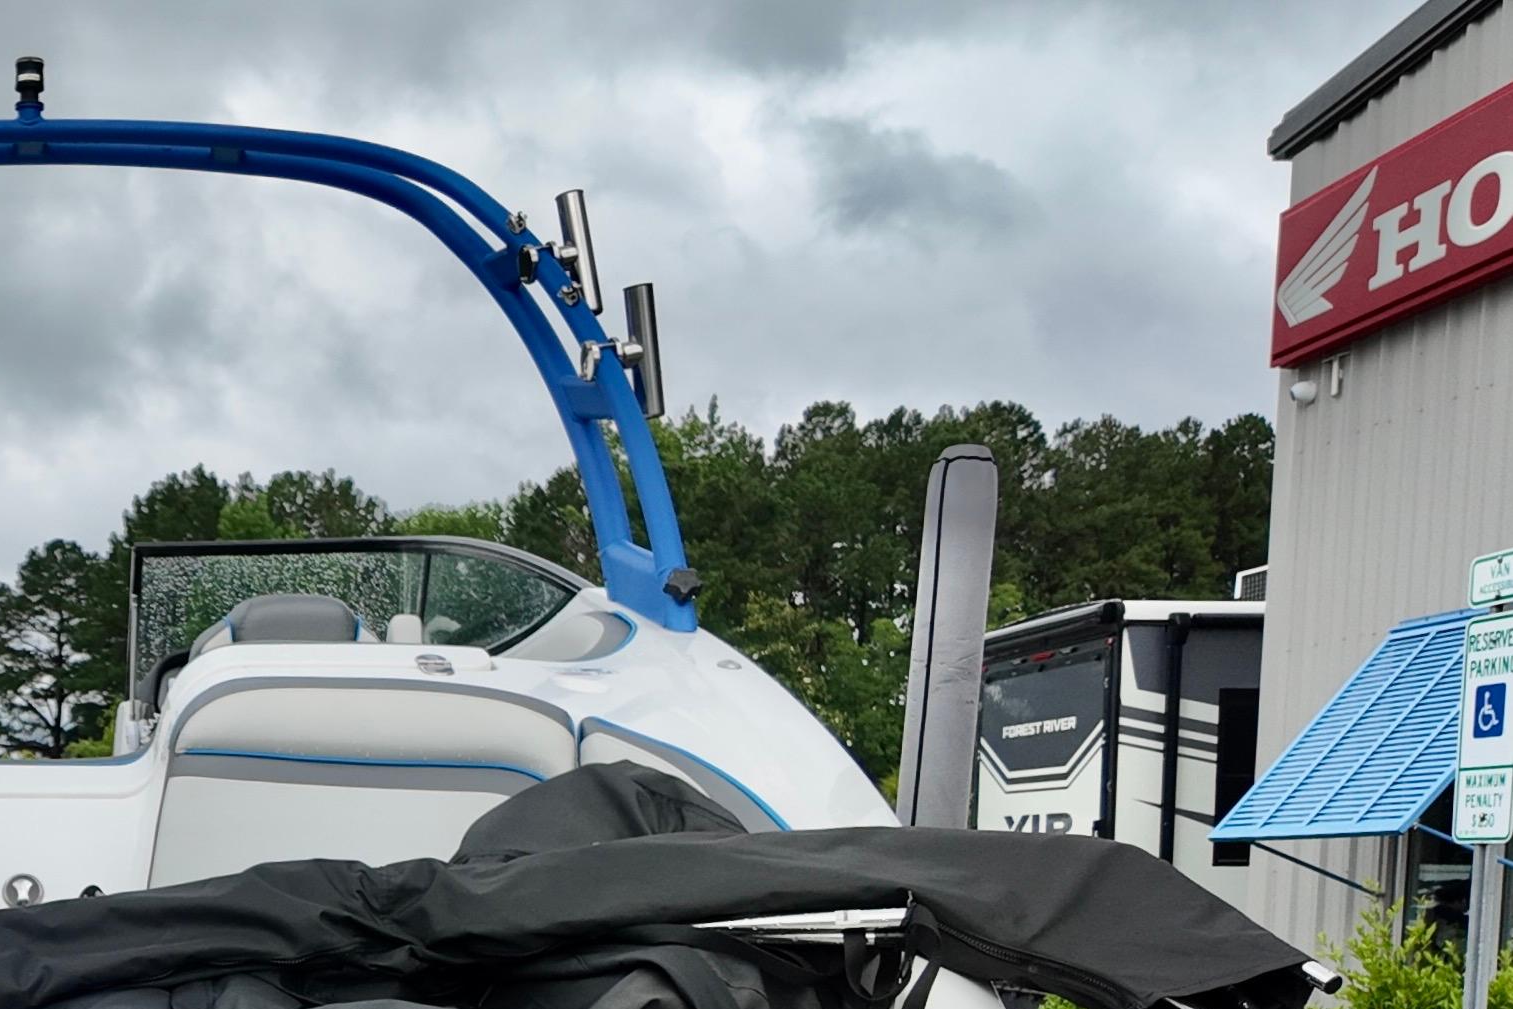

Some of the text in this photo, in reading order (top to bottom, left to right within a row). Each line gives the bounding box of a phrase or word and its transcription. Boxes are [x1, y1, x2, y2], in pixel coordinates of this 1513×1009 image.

[1368, 150, 1513, 291] HO
[1489, 563, 1510, 579] VAN
[1003, 716, 1076, 739] FOREST RIVER
[1466, 773, 1506, 788] MAXIMUM
[1465, 791, 1502, 808] PENALTY
